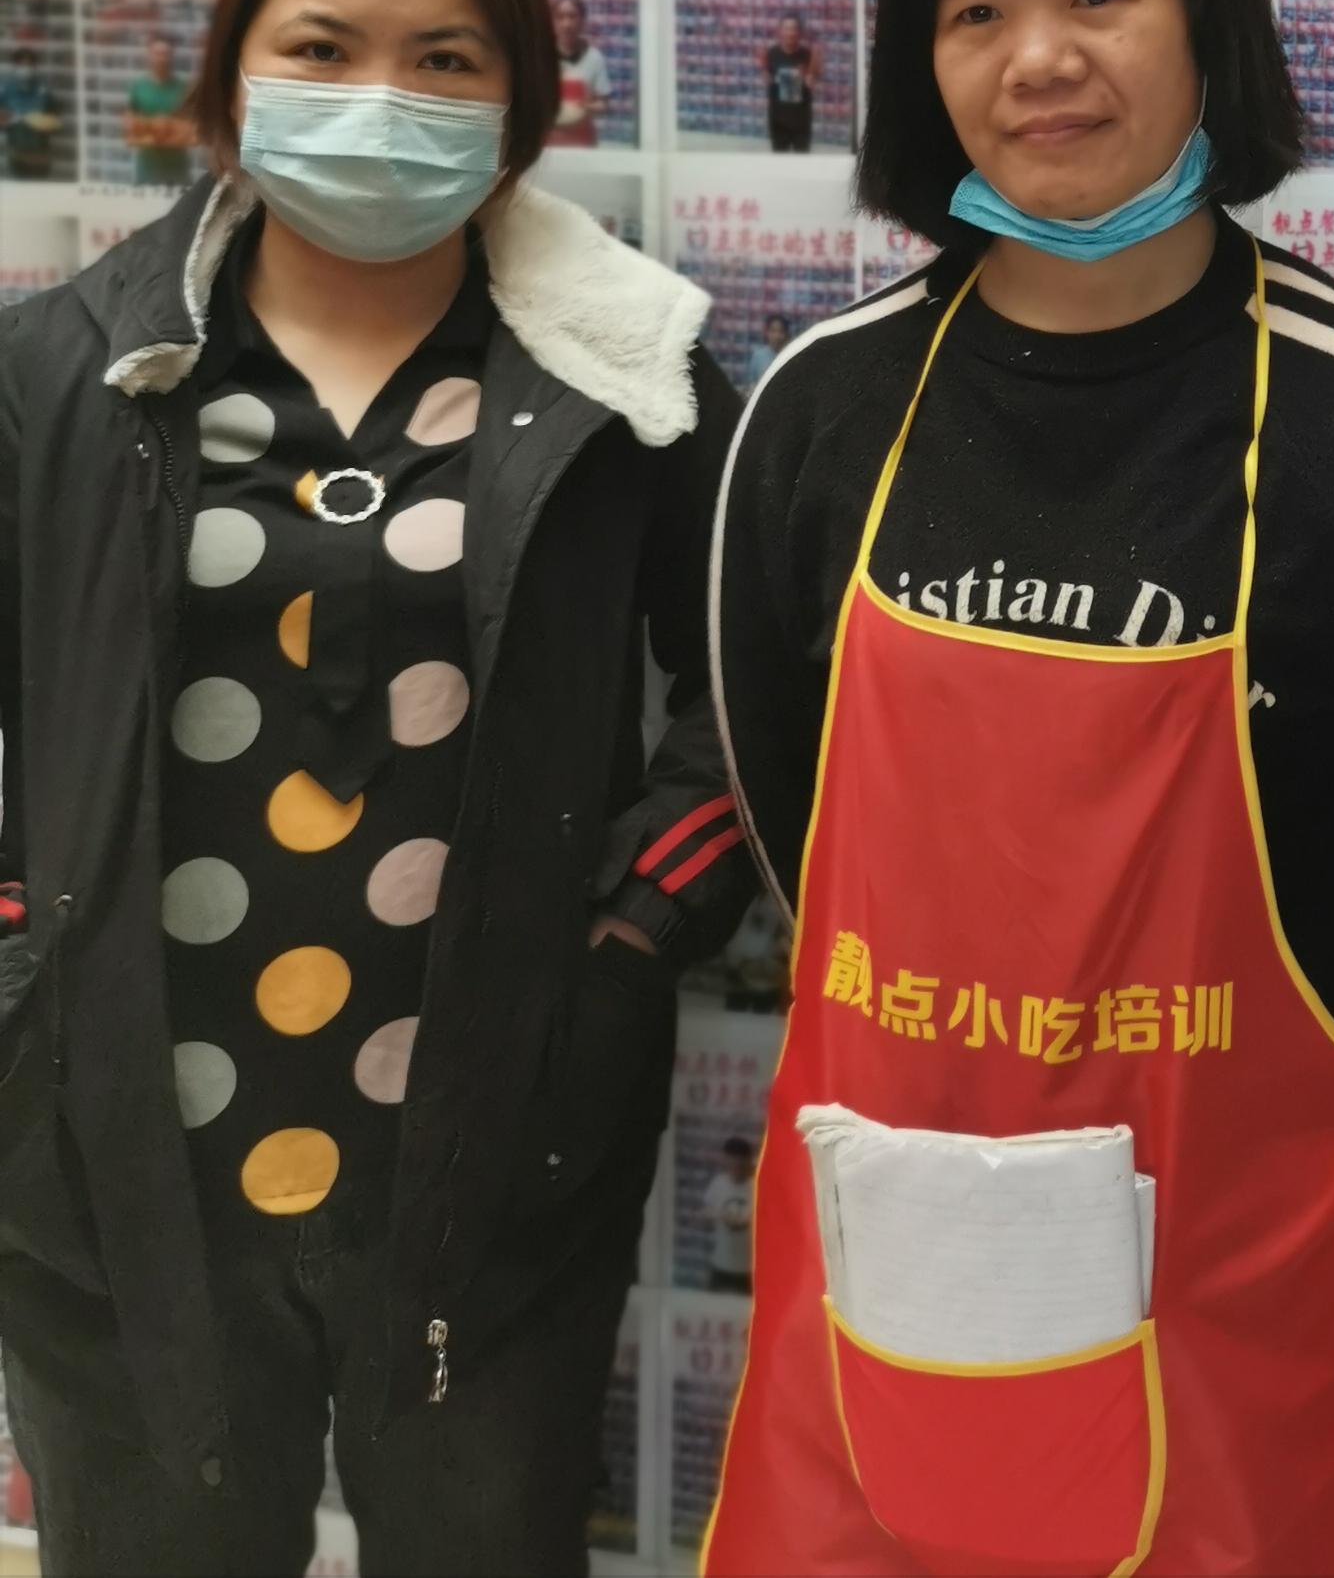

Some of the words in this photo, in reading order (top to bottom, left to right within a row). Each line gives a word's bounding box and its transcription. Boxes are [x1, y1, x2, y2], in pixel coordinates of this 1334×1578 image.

[822, 930, 1233, 1065] 靓点小吃培训
